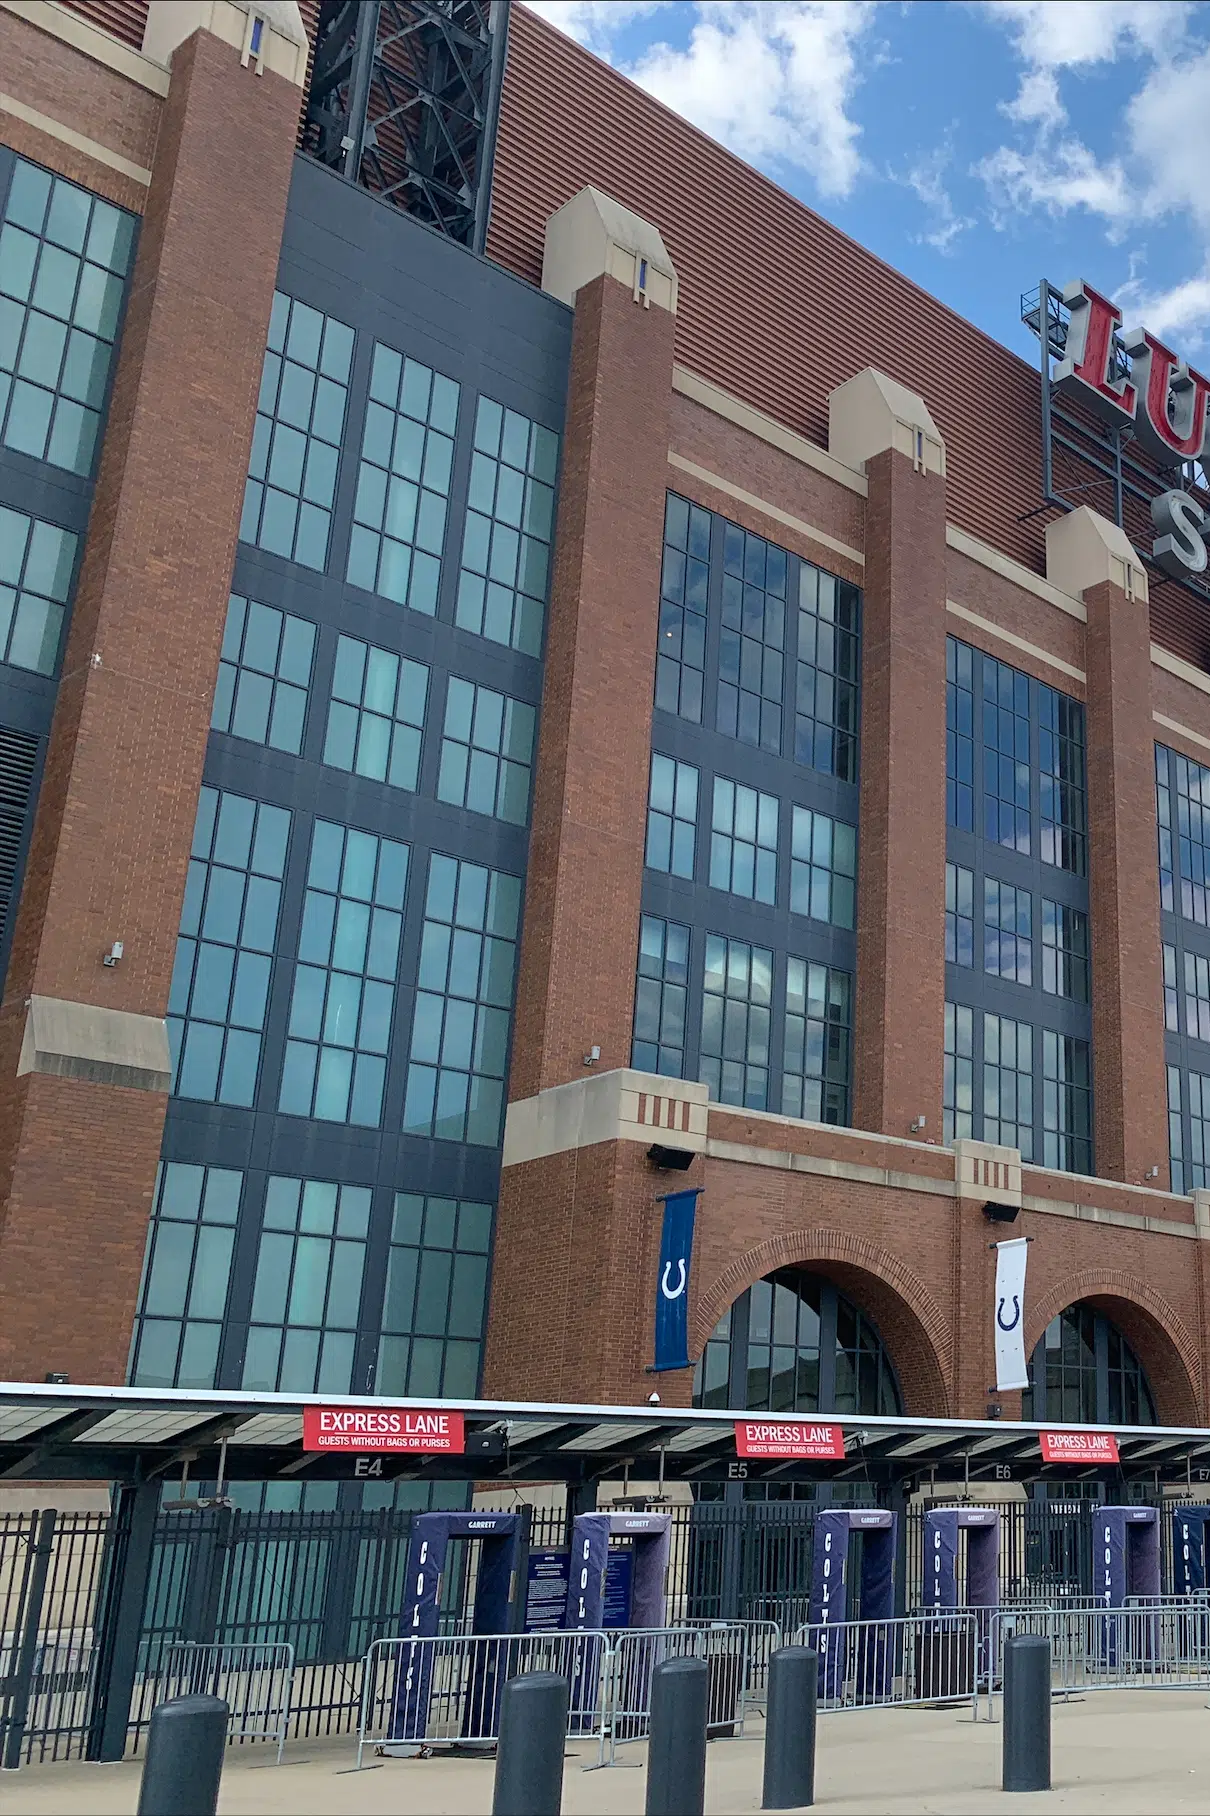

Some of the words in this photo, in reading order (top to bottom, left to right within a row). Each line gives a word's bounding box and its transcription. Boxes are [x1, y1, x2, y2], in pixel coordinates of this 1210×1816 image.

[320, 1412, 400, 1433] EXPRESS
[405, 1414, 449, 1434] LANE
[745, 1425, 800, 1442] EXPRESS
[802, 1427, 833, 1443] LANE
[318, 1436, 349, 1446] GUESTS
[351, 1437, 385, 1447] WITHOUT
[386, 1437, 408, 1447] BAGS
[409, 1438, 420, 1447] OR
[421, 1438, 450, 1448] PURSES
[1047, 1435, 1087, 1449] EXPRESS
[1087, 1436, 1110, 1449] LANE
[746, 1444, 768, 1453] GUESTS
[768, 1445, 792, 1454] WITHOUT
[792, 1445, 806, 1454] BAGS
[806, 1446, 815, 1454] OR
[815, 1446, 835, 1455] PURSES
[354, 1457, 383, 1477] E4
[728, 1462, 748, 1478] E5
[995, 1464, 1011, 1479] E6
[1200, 1468, 1210, 1480] E7
[468, 1521, 497, 1529] GARRETT
[625, 1520, 650, 1528] GARRETT
[820, 1533, 832, 1653] COLTS
